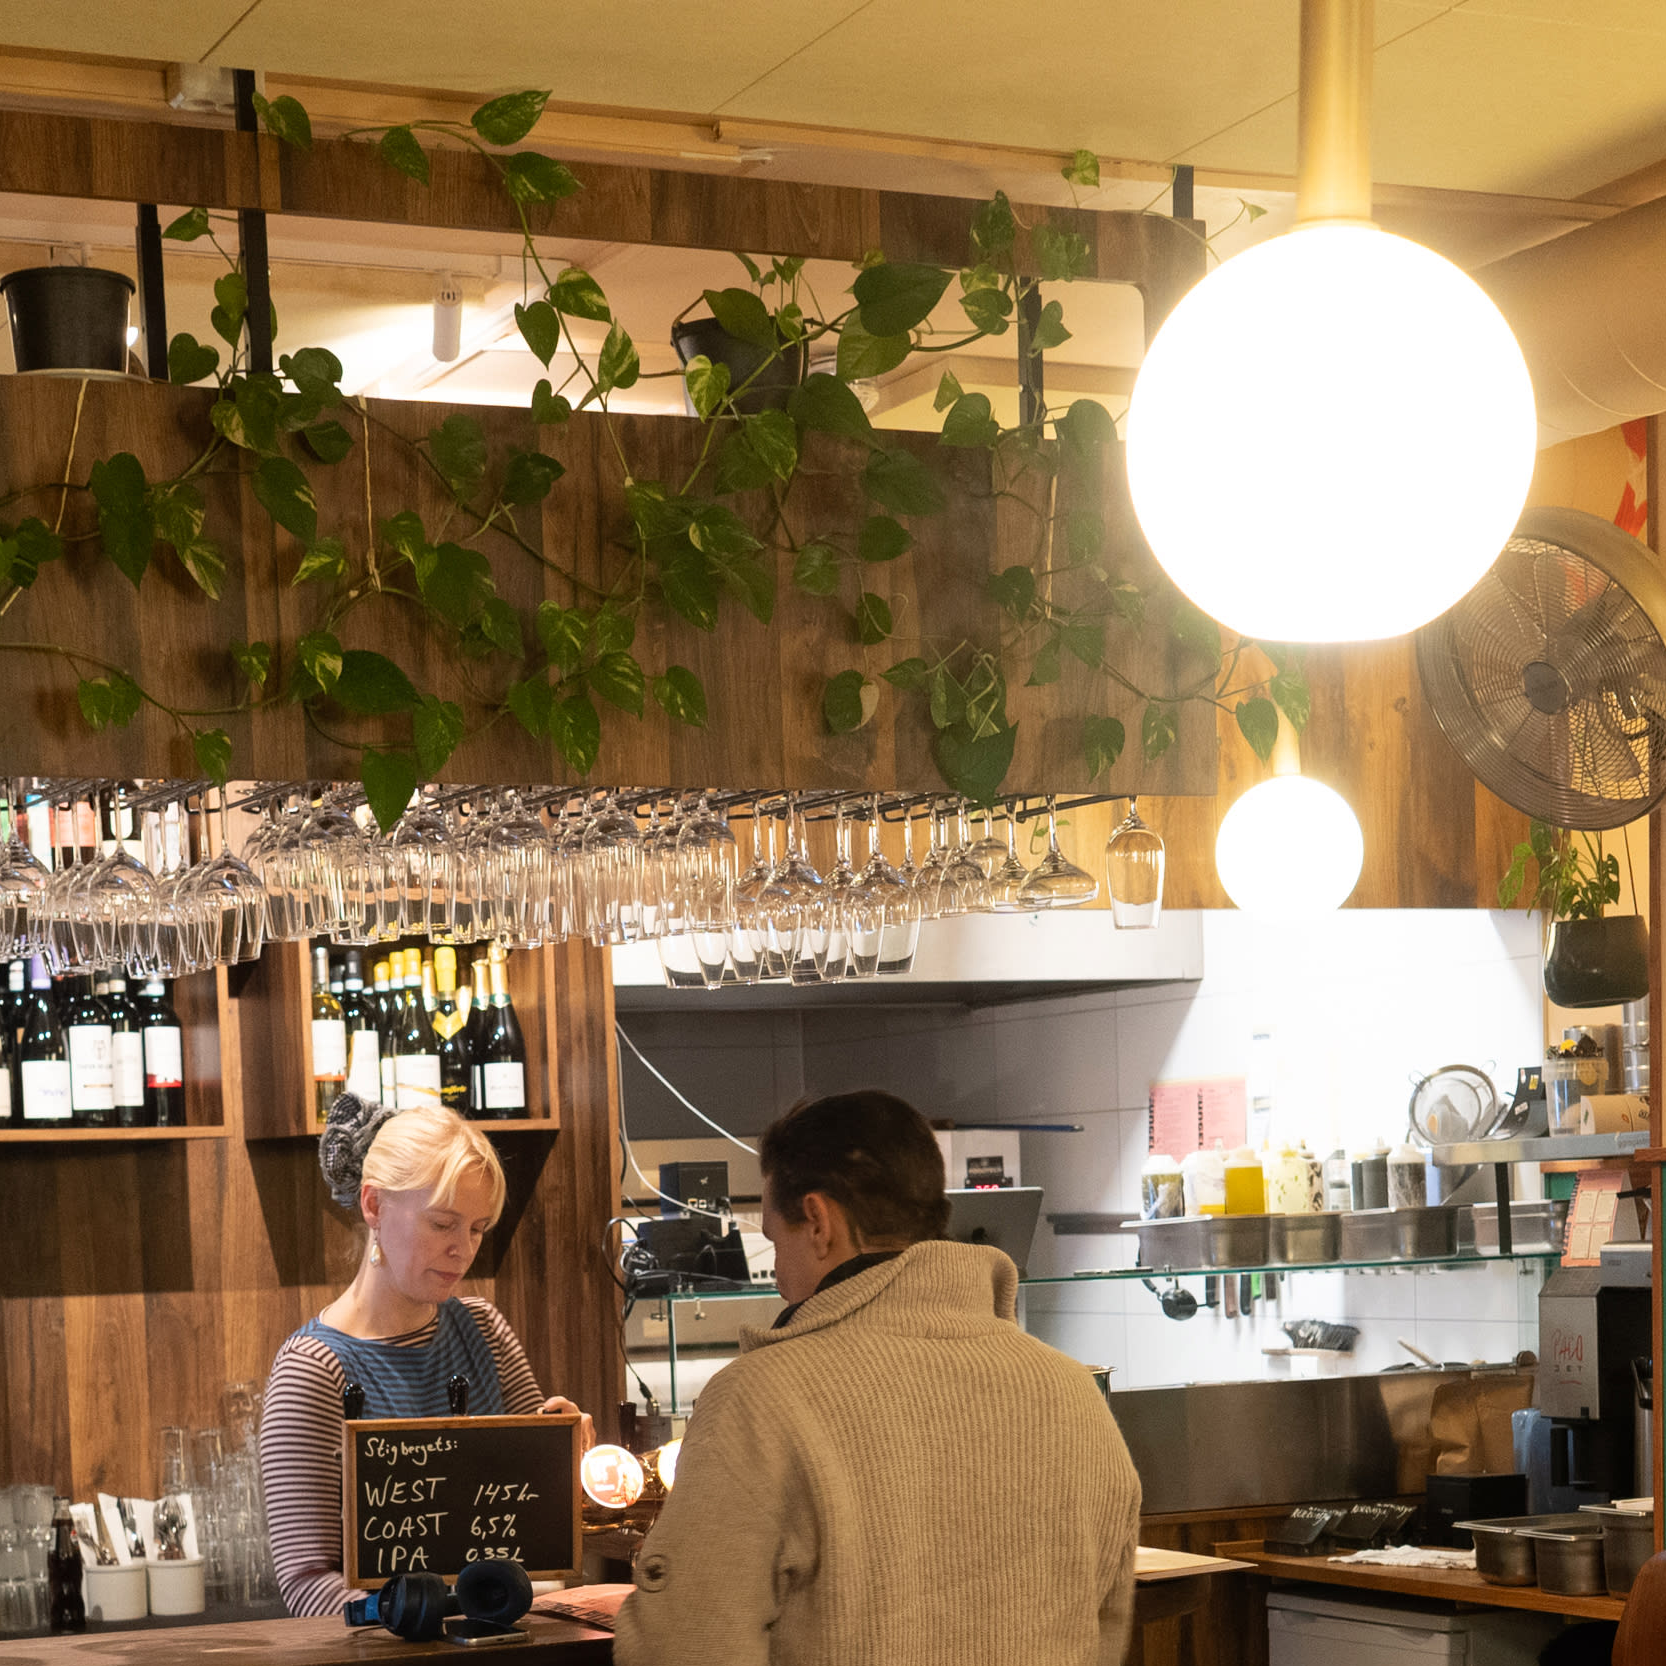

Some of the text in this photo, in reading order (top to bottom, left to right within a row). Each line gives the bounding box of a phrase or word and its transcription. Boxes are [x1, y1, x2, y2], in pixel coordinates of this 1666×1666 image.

[364, 1475, 447, 1507] WEST
[363, 1511, 518, 1542] COAST 6,5%
[377, 1545, 430, 1574] IPA
